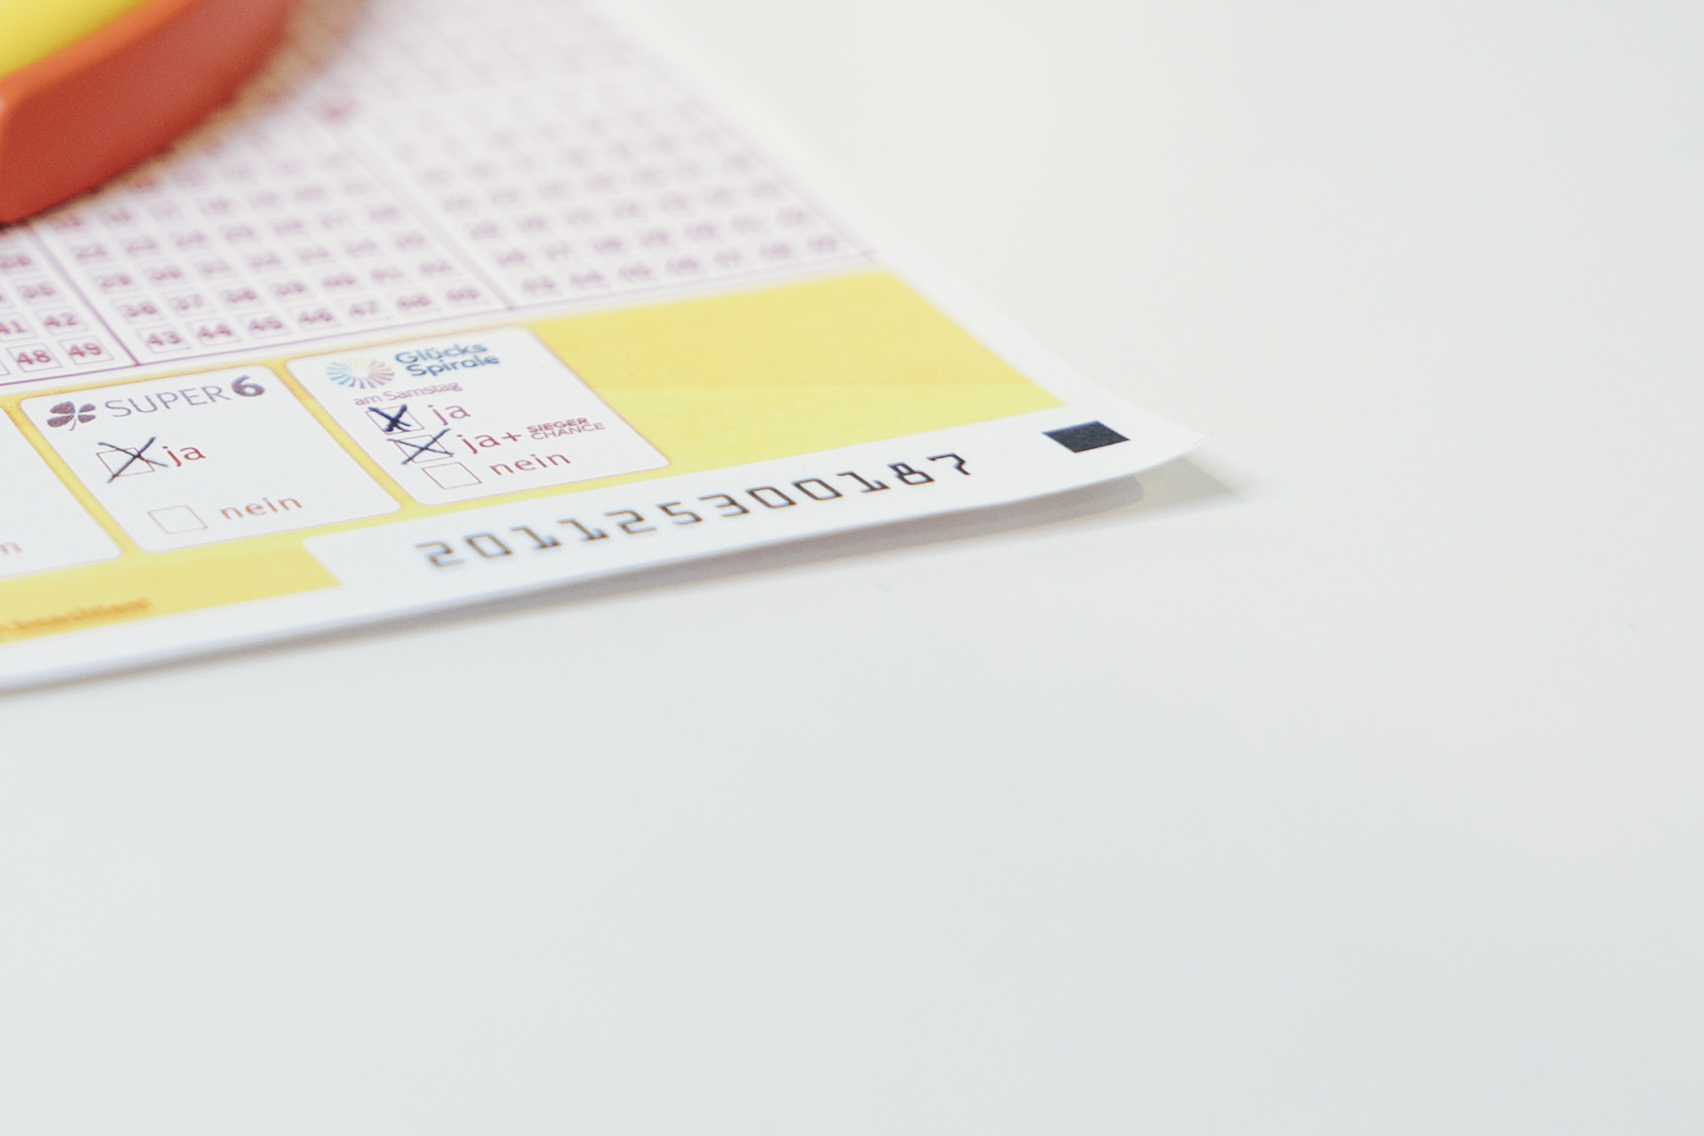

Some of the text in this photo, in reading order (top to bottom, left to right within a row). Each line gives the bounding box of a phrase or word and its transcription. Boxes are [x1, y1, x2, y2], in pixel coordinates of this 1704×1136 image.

[16, 351, 51, 365] 48
[394, 342, 489, 365] Glücks
[406, 355, 502, 377] Spirale
[353, 382, 463, 406] am Samstag
[427, 404, 472, 426] ja
[526, 417, 591, 433] SIEGER
[531, 422, 606, 440] CHANCE
[162, 445, 206, 467] ja
[489, 453, 571, 475] nein
[219, 497, 303, 520] nein
[415, 453, 972, 570] 201125300187
